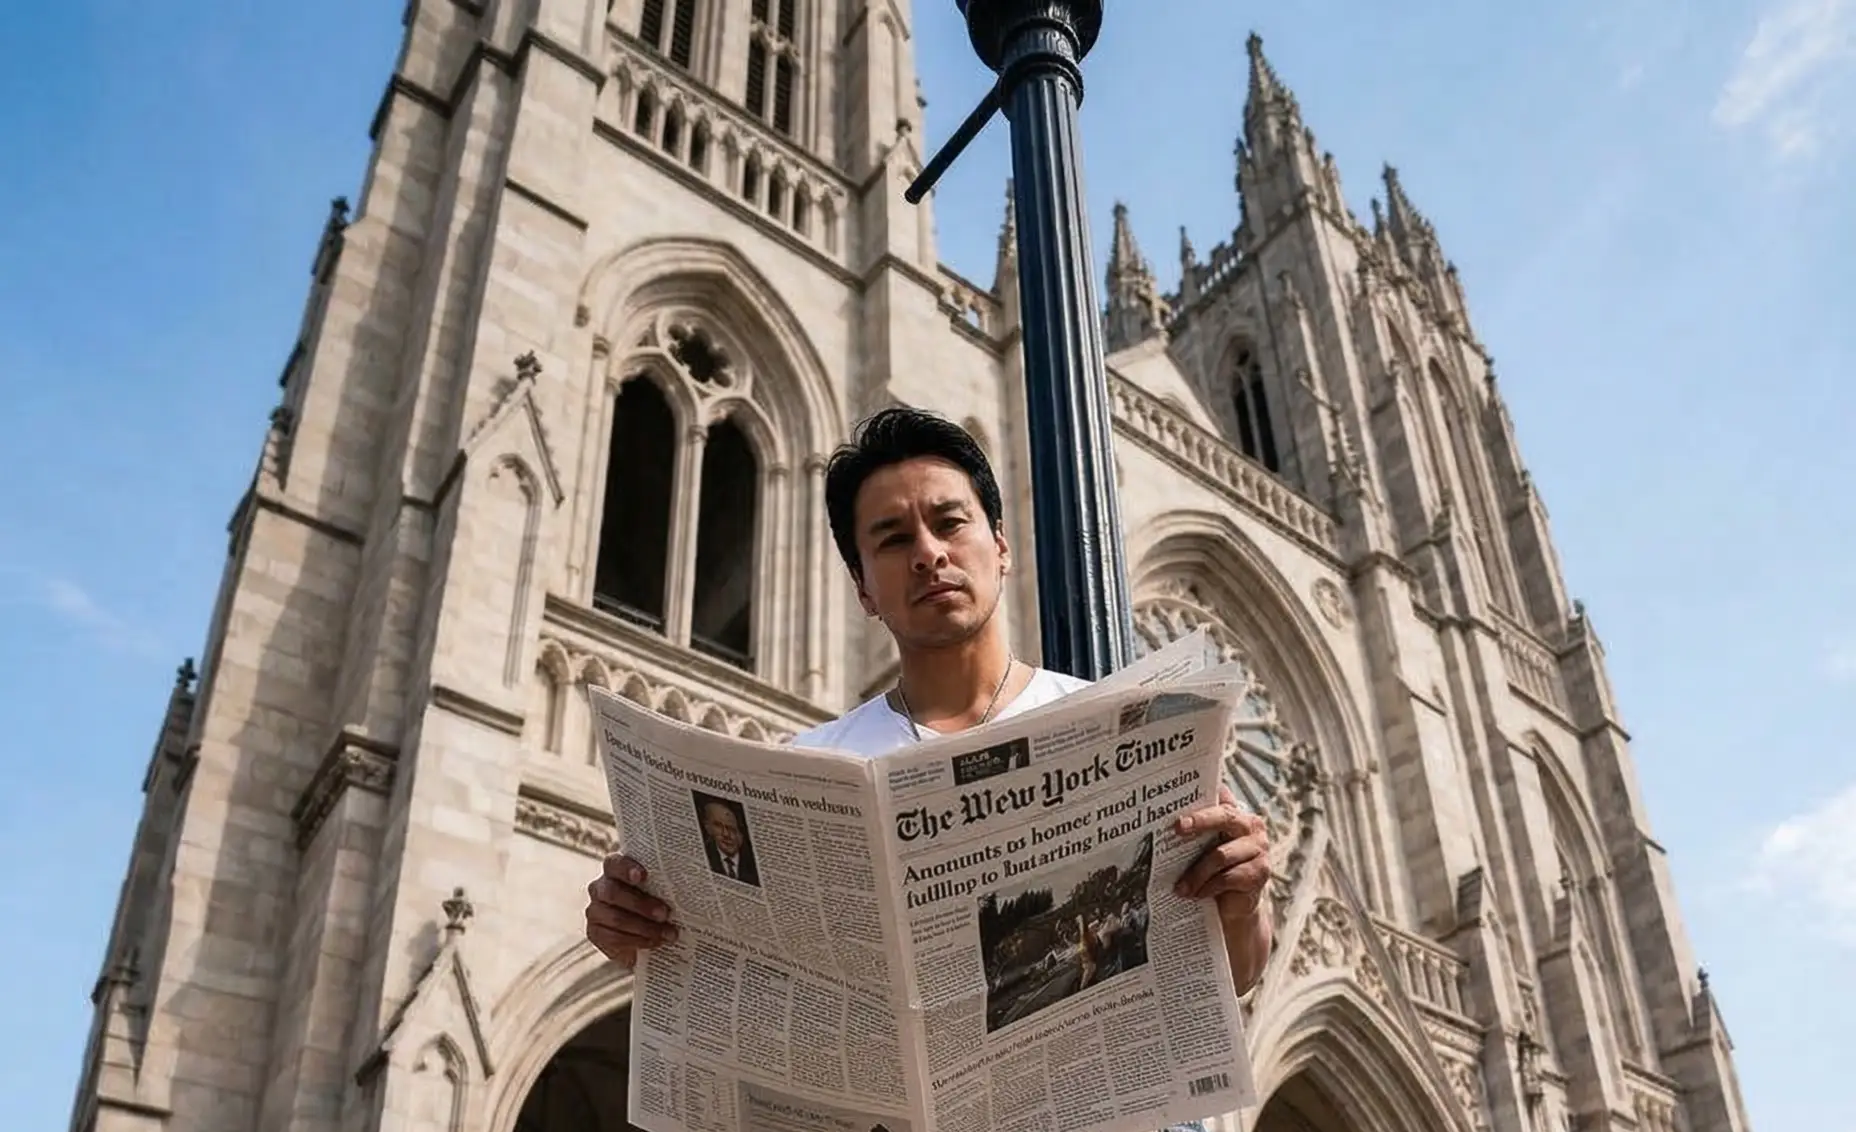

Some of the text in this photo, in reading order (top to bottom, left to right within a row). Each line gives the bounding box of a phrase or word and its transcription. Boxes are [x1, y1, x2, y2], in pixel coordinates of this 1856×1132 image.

[895, 806, 954, 842] The
[1041, 753, 1111, 808] York
[1115, 727, 1196, 773] Times
[981, 871, 999, 886] to
[1097, 810, 1142, 846] hand
